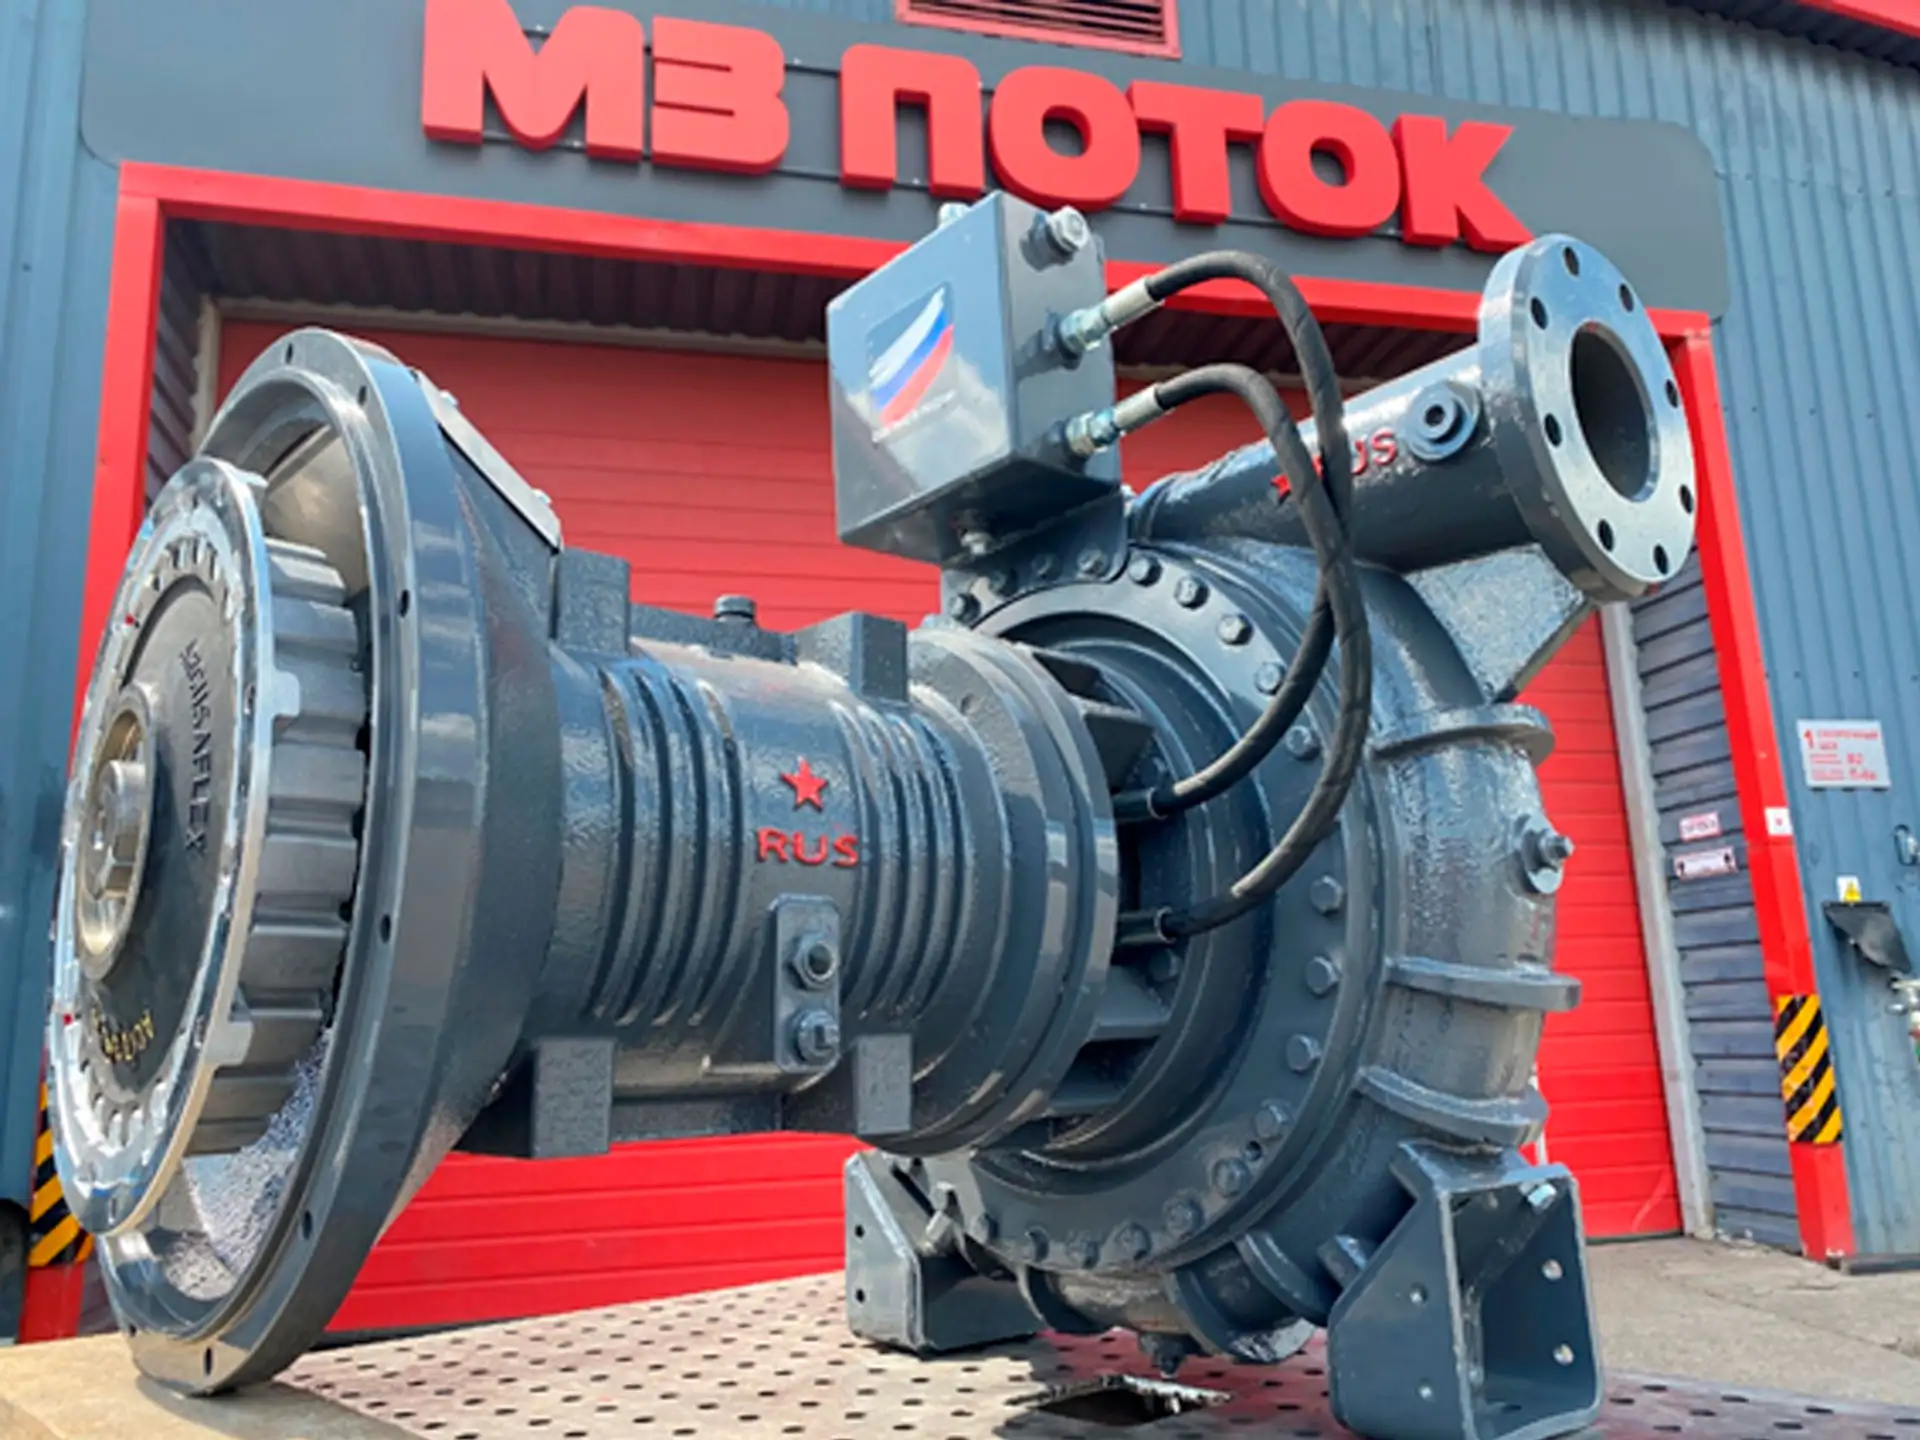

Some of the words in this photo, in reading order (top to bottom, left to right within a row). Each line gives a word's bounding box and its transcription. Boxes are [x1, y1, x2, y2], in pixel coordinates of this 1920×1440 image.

[421, 0, 790, 174] МЗ
[838, 43, 1532, 251] ПОТОК
[756, 827, 859, 866] RUS
